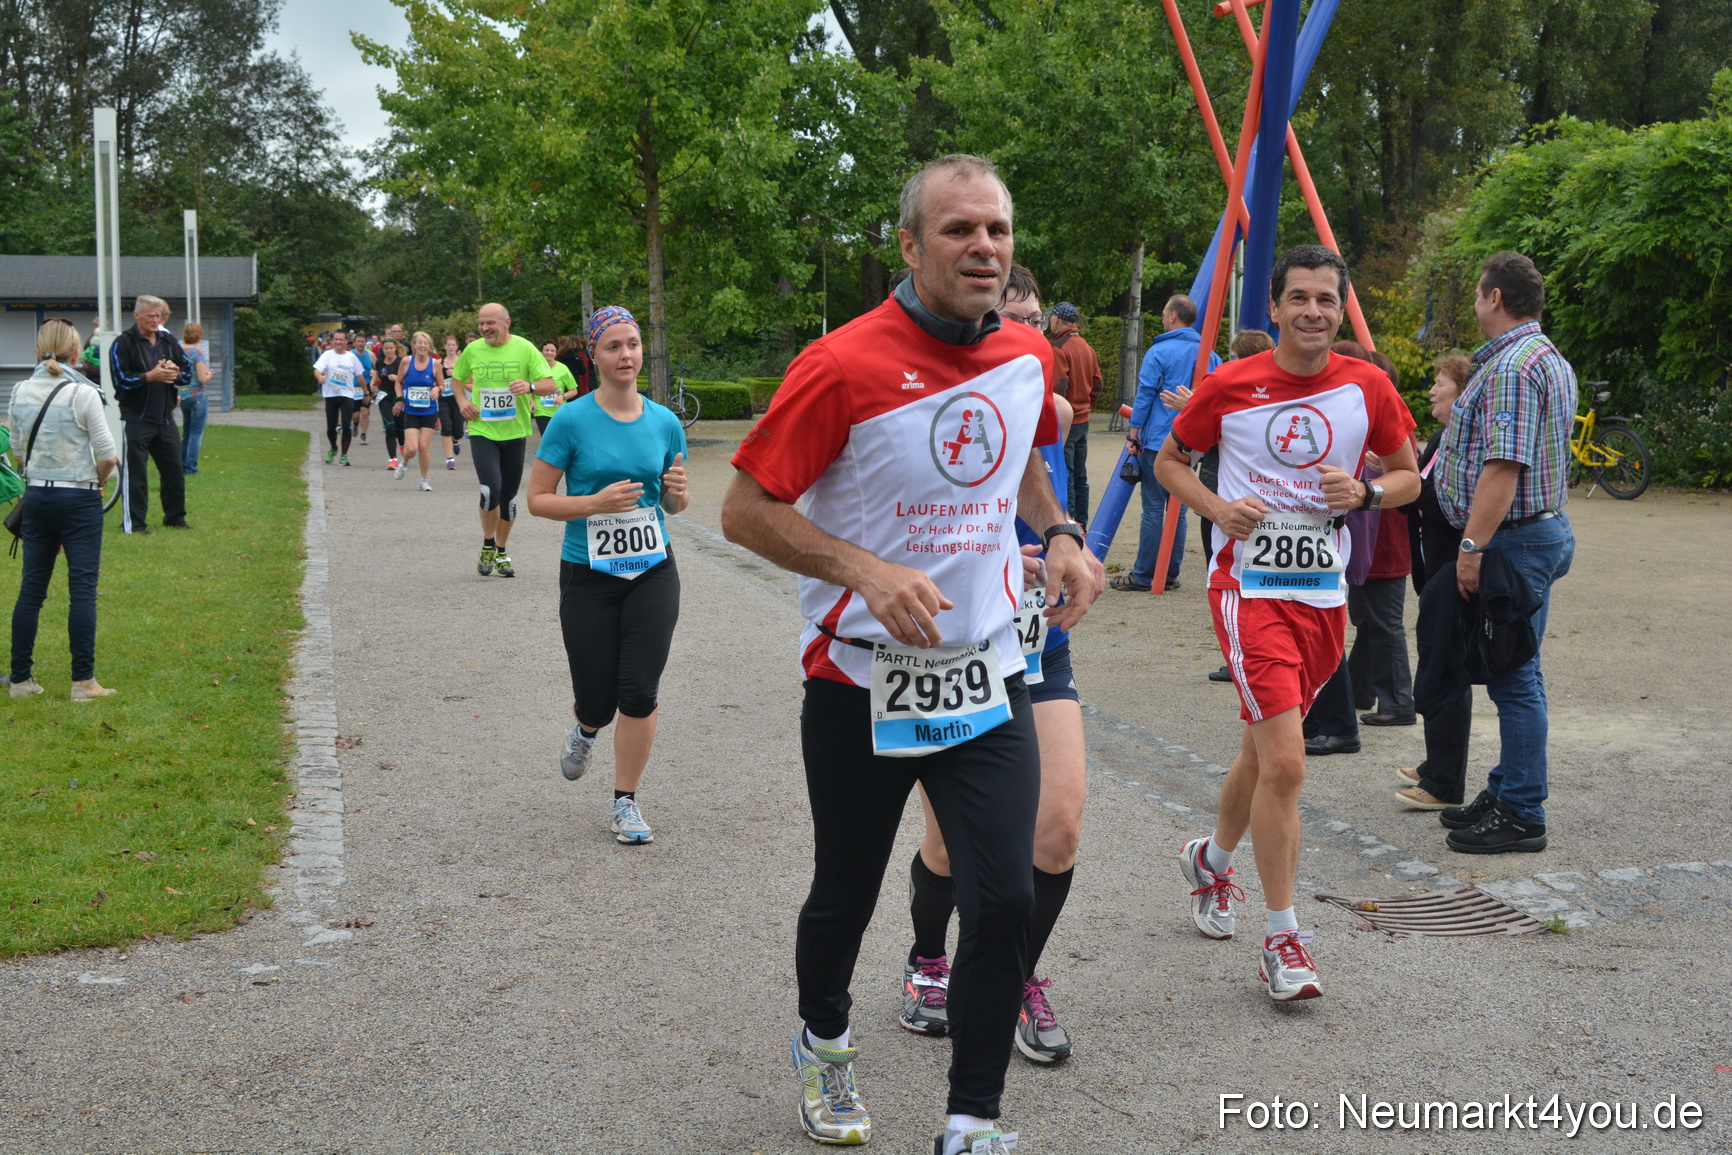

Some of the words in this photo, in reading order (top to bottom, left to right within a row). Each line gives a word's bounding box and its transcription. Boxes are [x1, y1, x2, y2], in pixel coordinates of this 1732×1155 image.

[902, 381, 924, 390] erima
[411, 391, 428, 399] 2722
[484, 395, 513, 408] 2162
[1293, 480, 1314, 489] MIT
[896, 501, 957, 517] LAUFEN
[961, 503, 989, 515] MIT
[588, 518, 613, 527] PARTL
[615, 516, 647, 525] Neumarkt
[1281, 521, 1321, 532] Neumarkt
[908, 524, 925, 535] Dr.
[929, 524, 954, 535] Heck
[966, 524, 983, 533] Dr.
[596, 525, 657, 556] 2800
[1252, 535, 1334, 568] 2866
[609, 559, 649, 572] Melanie
[1259, 575, 1320, 587] Johannes
[875, 651, 921, 668] PARTL
[924, 645, 977, 669] Neumarkt
[886, 659, 992, 713] 2939
[915, 720, 973, 742] Martin
